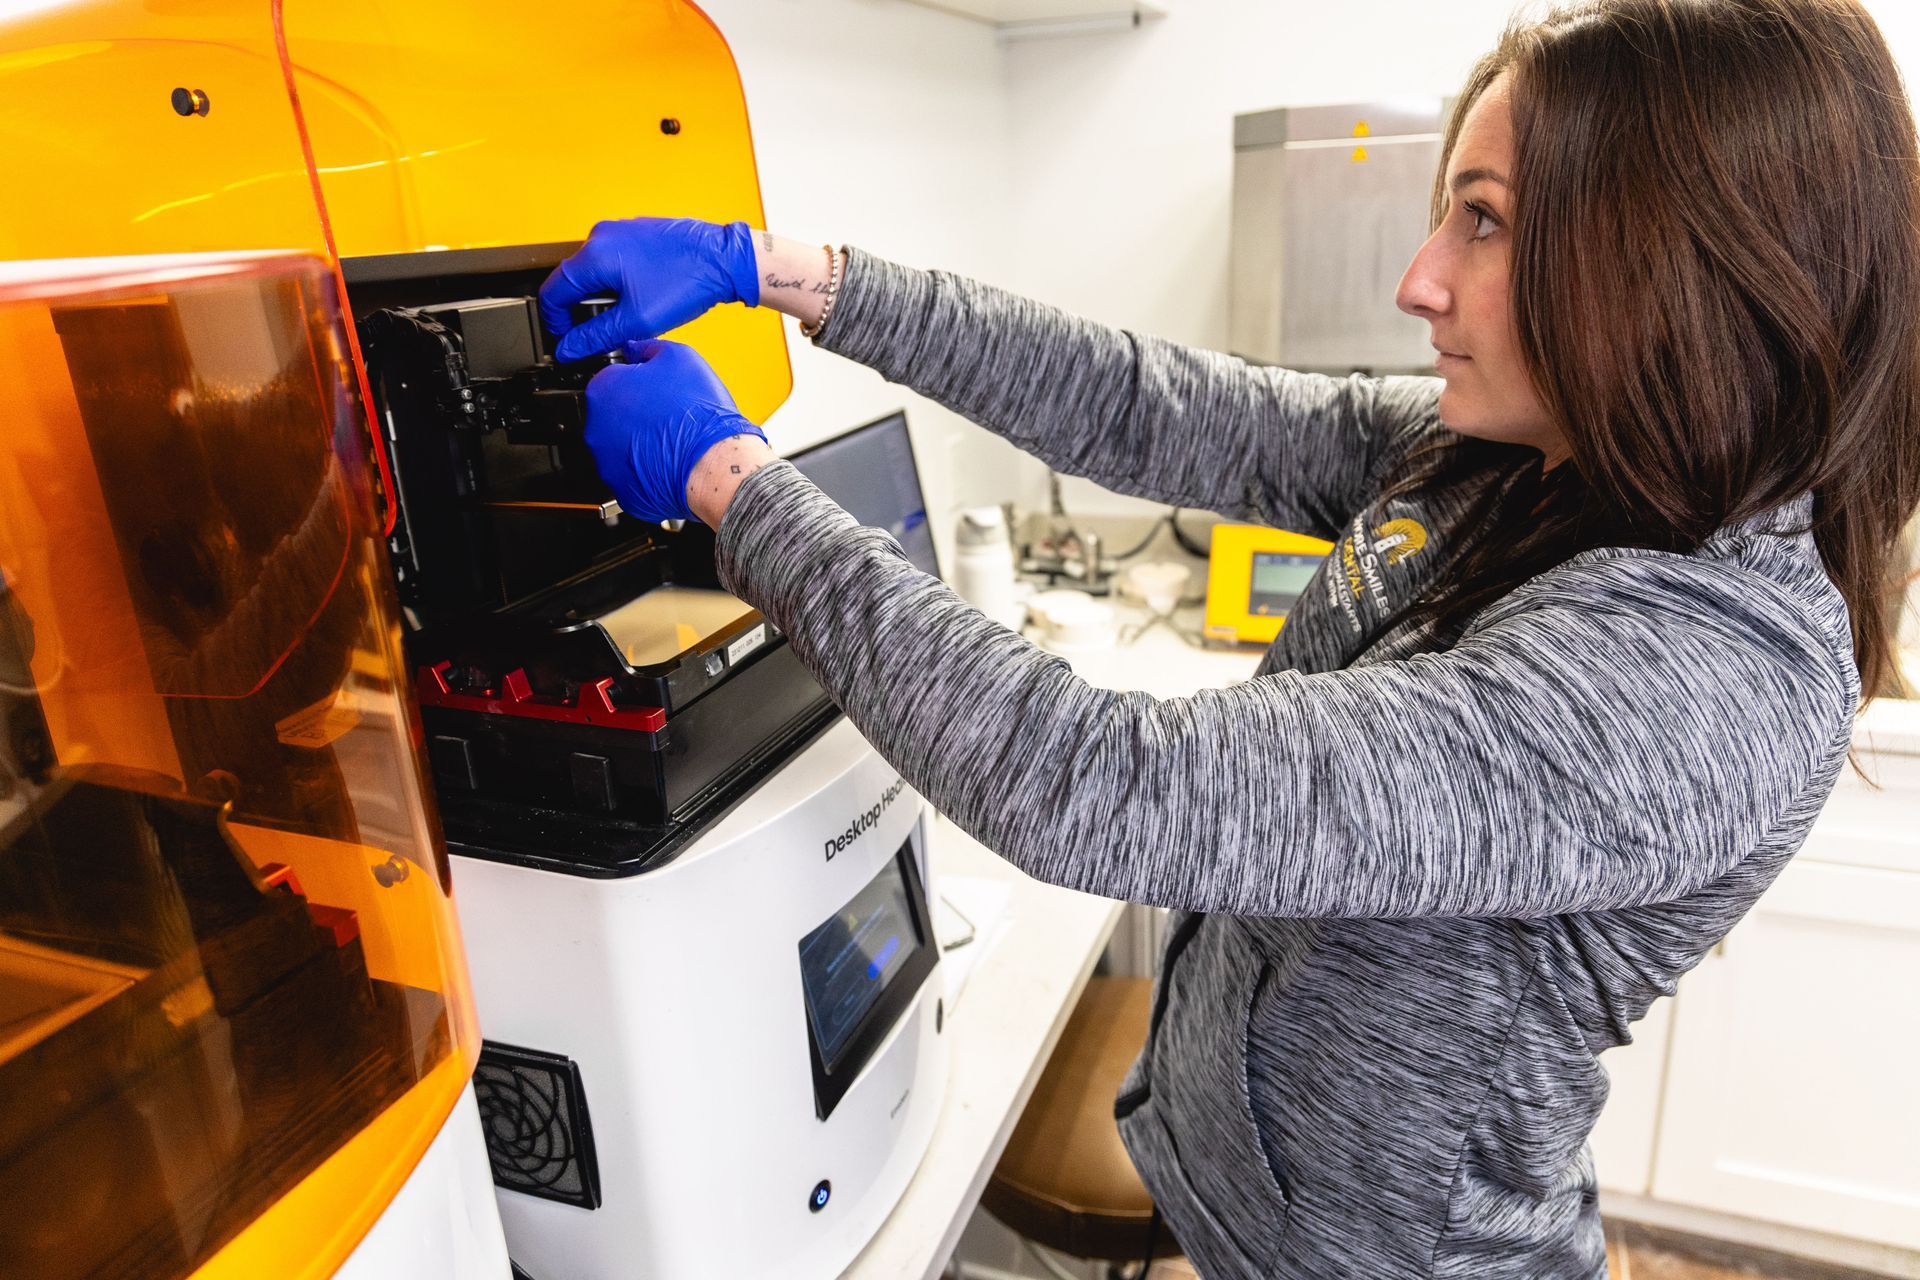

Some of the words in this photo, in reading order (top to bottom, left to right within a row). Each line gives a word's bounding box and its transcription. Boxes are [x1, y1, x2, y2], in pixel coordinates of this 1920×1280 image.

[1361, 554, 1390, 618] SMILES
[825, 803, 881, 862] Desktop
[881, 779, 906, 811] Hea
